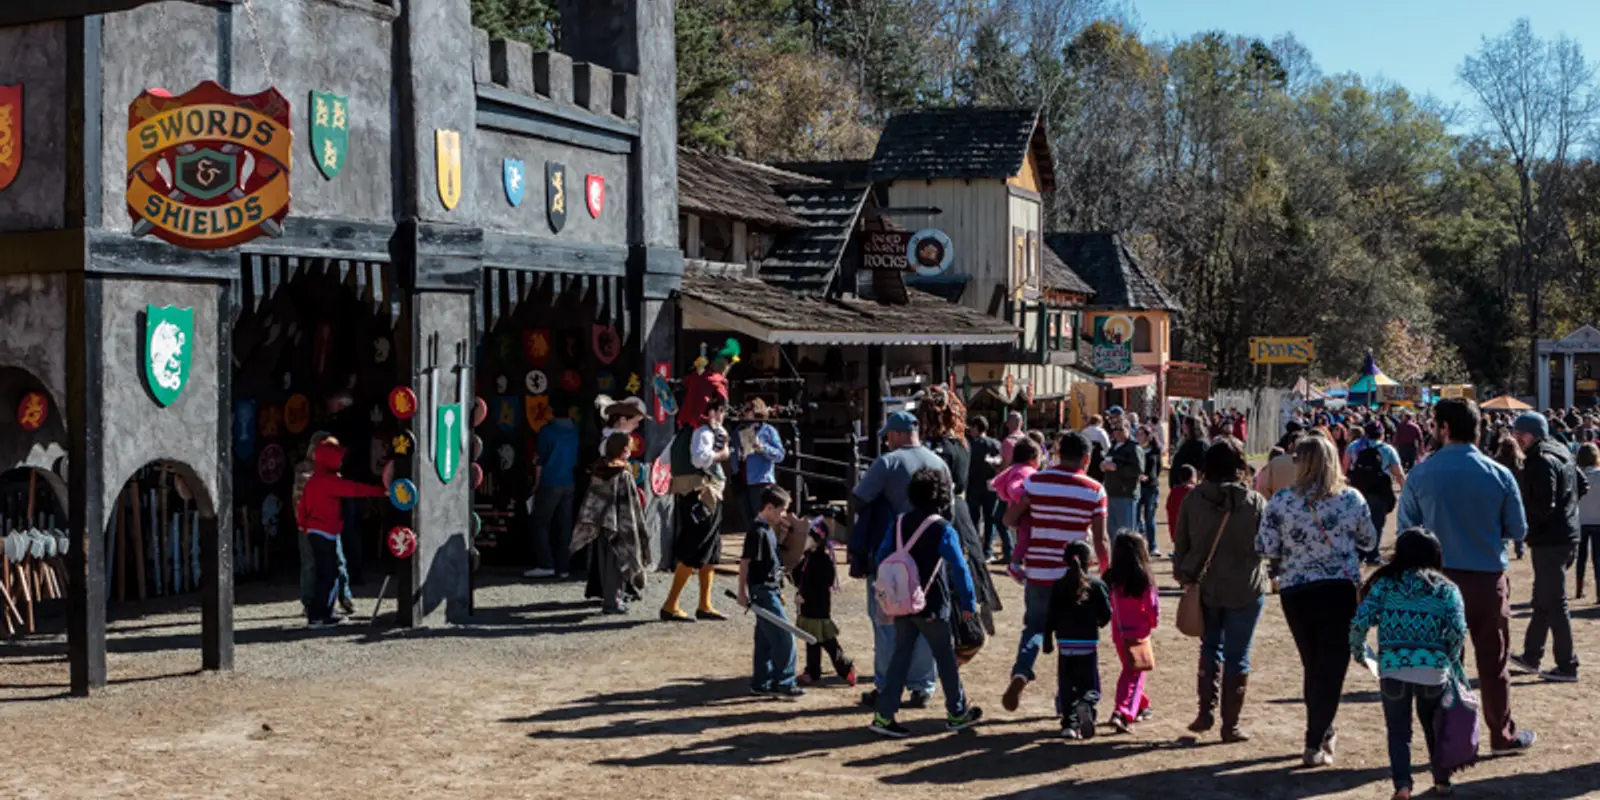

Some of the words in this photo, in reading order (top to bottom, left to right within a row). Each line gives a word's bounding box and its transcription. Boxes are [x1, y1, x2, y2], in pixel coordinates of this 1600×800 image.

[139, 109, 277, 150] SWORDS
[196, 158, 220, 187] &
[144, 193, 263, 235] SHIELDS
[864, 254, 908, 269] ROCKS
